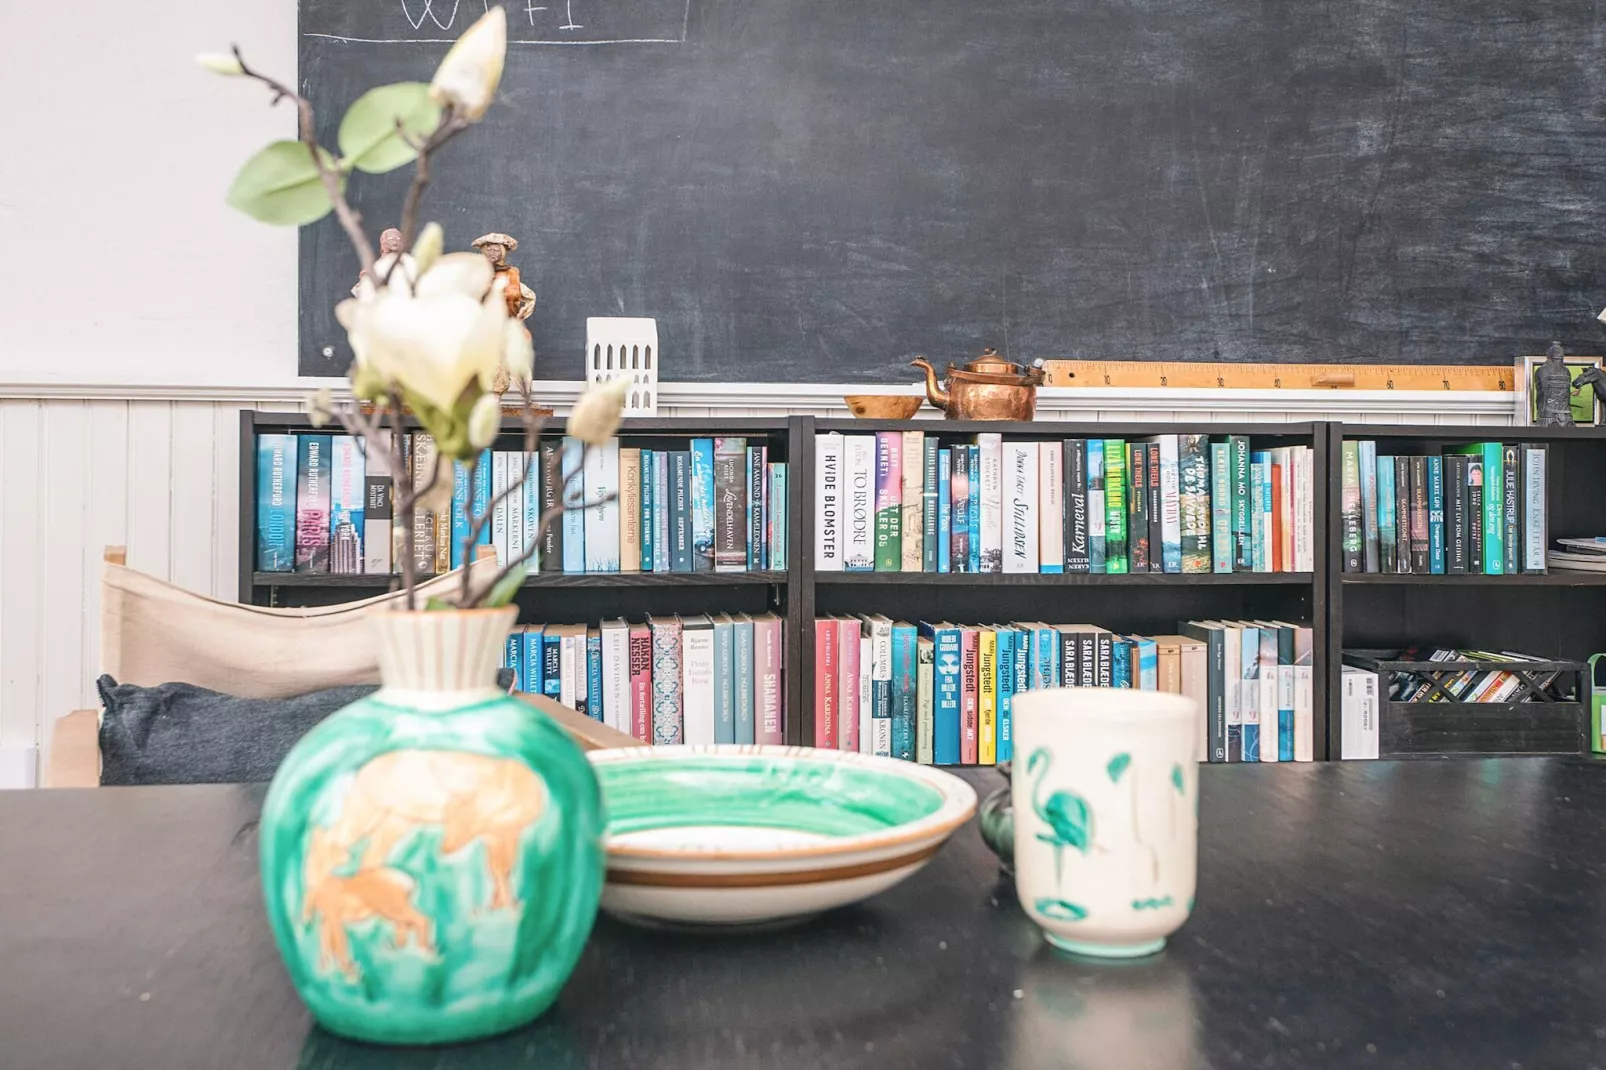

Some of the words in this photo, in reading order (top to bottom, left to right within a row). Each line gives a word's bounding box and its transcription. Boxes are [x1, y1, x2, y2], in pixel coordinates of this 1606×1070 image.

[1104, 375, 1111, 385] 10
[1160, 377, 1168, 387] 20
[1217, 378, 1225, 388] 30
[1386, 380, 1395, 390] 60
[1442, 380, 1450, 390] 70
[1498, 381, 1507, 391] 80
[308, 442, 319, 466] EDWARD
[880, 438, 888, 476] BENNETT
[1107, 446, 1120, 462] LIZA
[1150, 448, 1158, 464] LONE
[1532, 454, 1540, 475] JOHN
[825, 455, 836, 490] HVIDE
[854, 469, 867, 488] TO
[1150, 466, 1158, 487] THEILS
[1185, 468, 1196, 482] DE
[1196, 456, 1206, 502] THOMAS
[1346, 452, 1354, 484] MARIA
[1506, 470, 1514, 488] JULIE
[272, 468, 282, 506] RUTHERFURD
[1108, 466, 1122, 507] MARKLUND
[1238, 482, 1245, 496] MO
[1532, 477, 1540, 504] IRVING
[546, 500, 554, 508] ER
[626, 466, 636, 544] Konkyliesamlerne
[879, 489, 888, 530] SKILLER
[890, 496, 898, 512] DET
[941, 504, 950, 514] The
[1166, 491, 1177, 525] MAYDAY
[1506, 490, 1514, 524] HASTRUP
[269, 509, 284, 546] LONDON
[302, 510, 321, 546] PARIS
[724, 488, 738, 550] LAVENDELHAVEN
[824, 496, 836, 559] BLOMSTER
[854, 491, 867, 546] BRØDRE
[890, 518, 898, 537] DER
[1072, 493, 1085, 554] Karneval
[1347, 496, 1357, 552] HELLEBERG
[341, 525, 350, 541] YORK
[440, 522, 448, 546] Markus
[878, 534, 888, 547] OS
[440, 548, 448, 560] Nat
[942, 635, 956, 643] ROBERT
[1065, 640, 1075, 661] SARA
[1083, 640, 1092, 660] SARA
[1100, 639, 1110, 660] SARA
[591, 652, 600, 676] MARCIA
[631, 638, 640, 676] NESSER
[641, 638, 650, 670] HÅKAN
[964, 649, 976, 692] Jungstedt
[982, 652, 992, 693] Jungstedt
[1000, 649, 1012, 692] Jungstedt
[1015, 648, 1028, 692] Jungstedt
[846, 672, 854, 693] ANNA
[764, 674, 776, 732] SHAMANEN
[846, 696, 854, 734] KARENINA
[942, 700, 956, 708] BILLEDE
[640, 724, 644, 734] om
